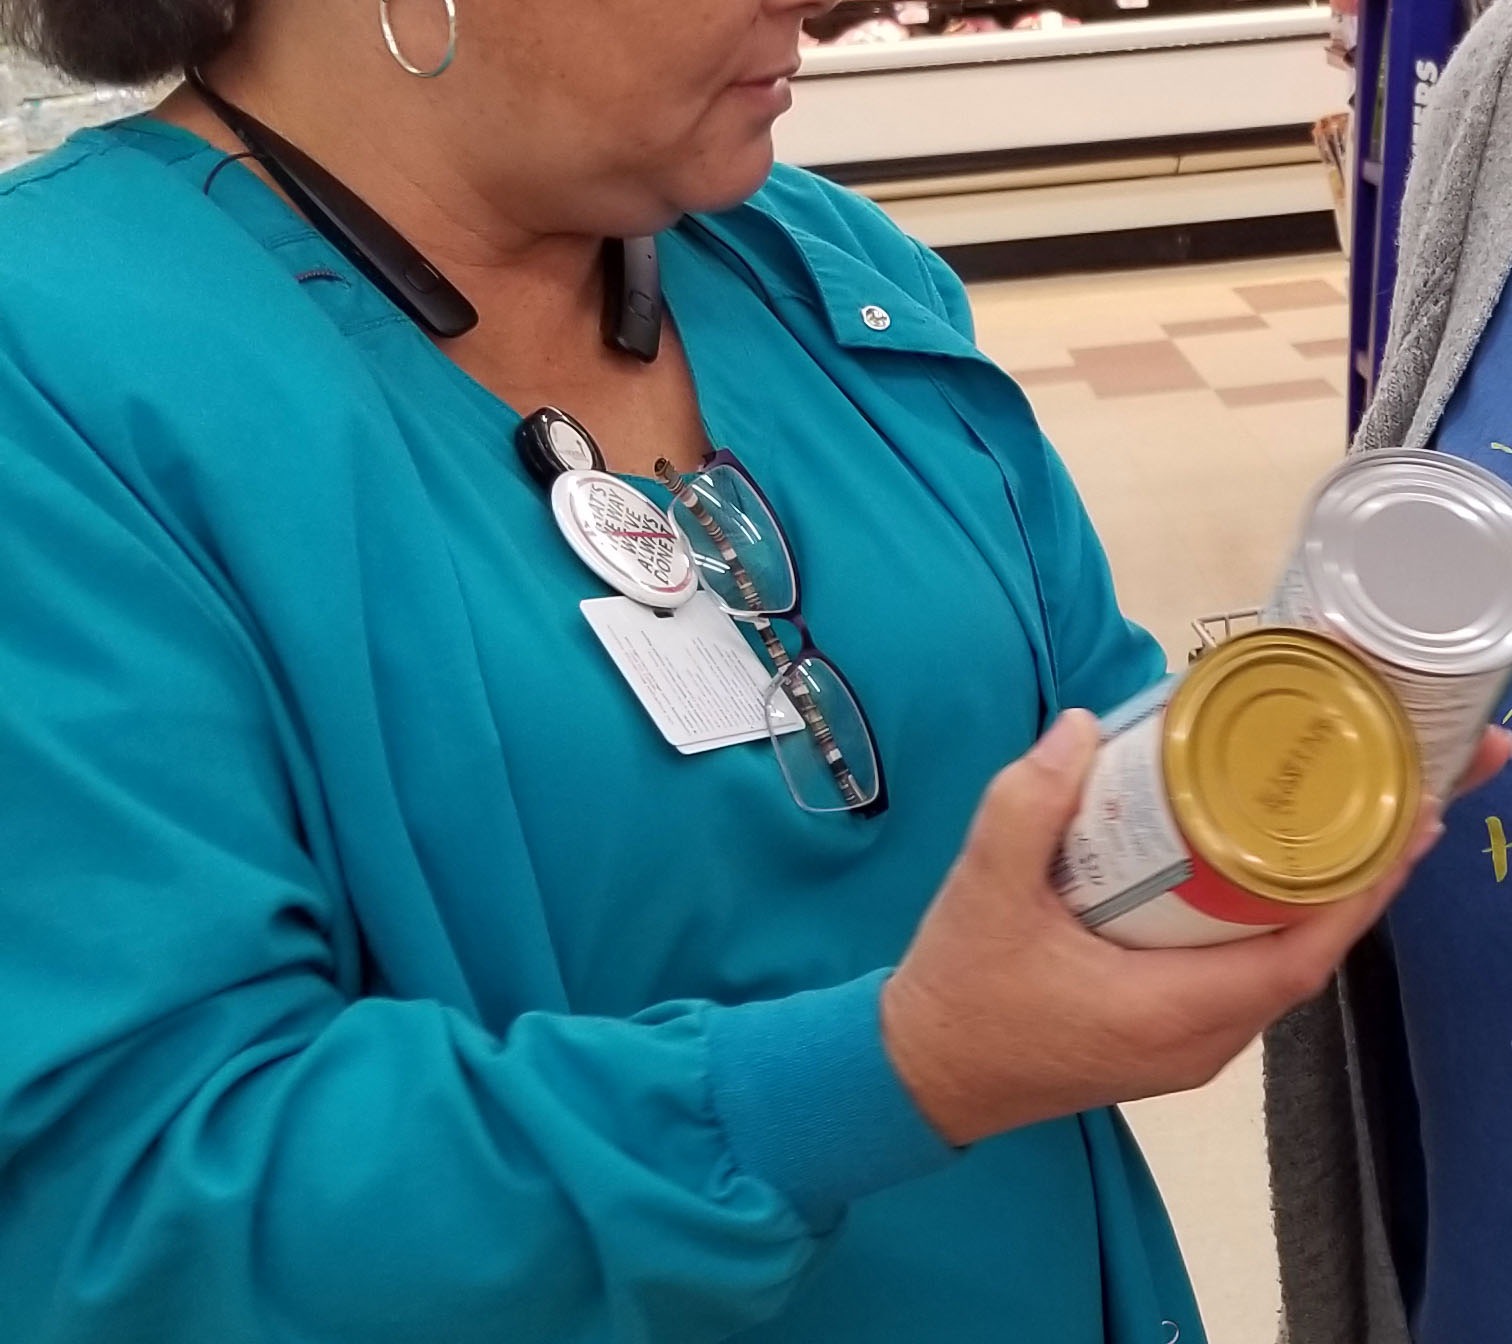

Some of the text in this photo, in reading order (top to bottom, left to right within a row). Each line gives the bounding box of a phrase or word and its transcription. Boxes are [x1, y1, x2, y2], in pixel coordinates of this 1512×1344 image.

[606, 488, 625, 522] WAY
[620, 507, 642, 555] WE'VE
[637, 513, 659, 574] ALWAYS
[653, 543, 674, 586] DONE
